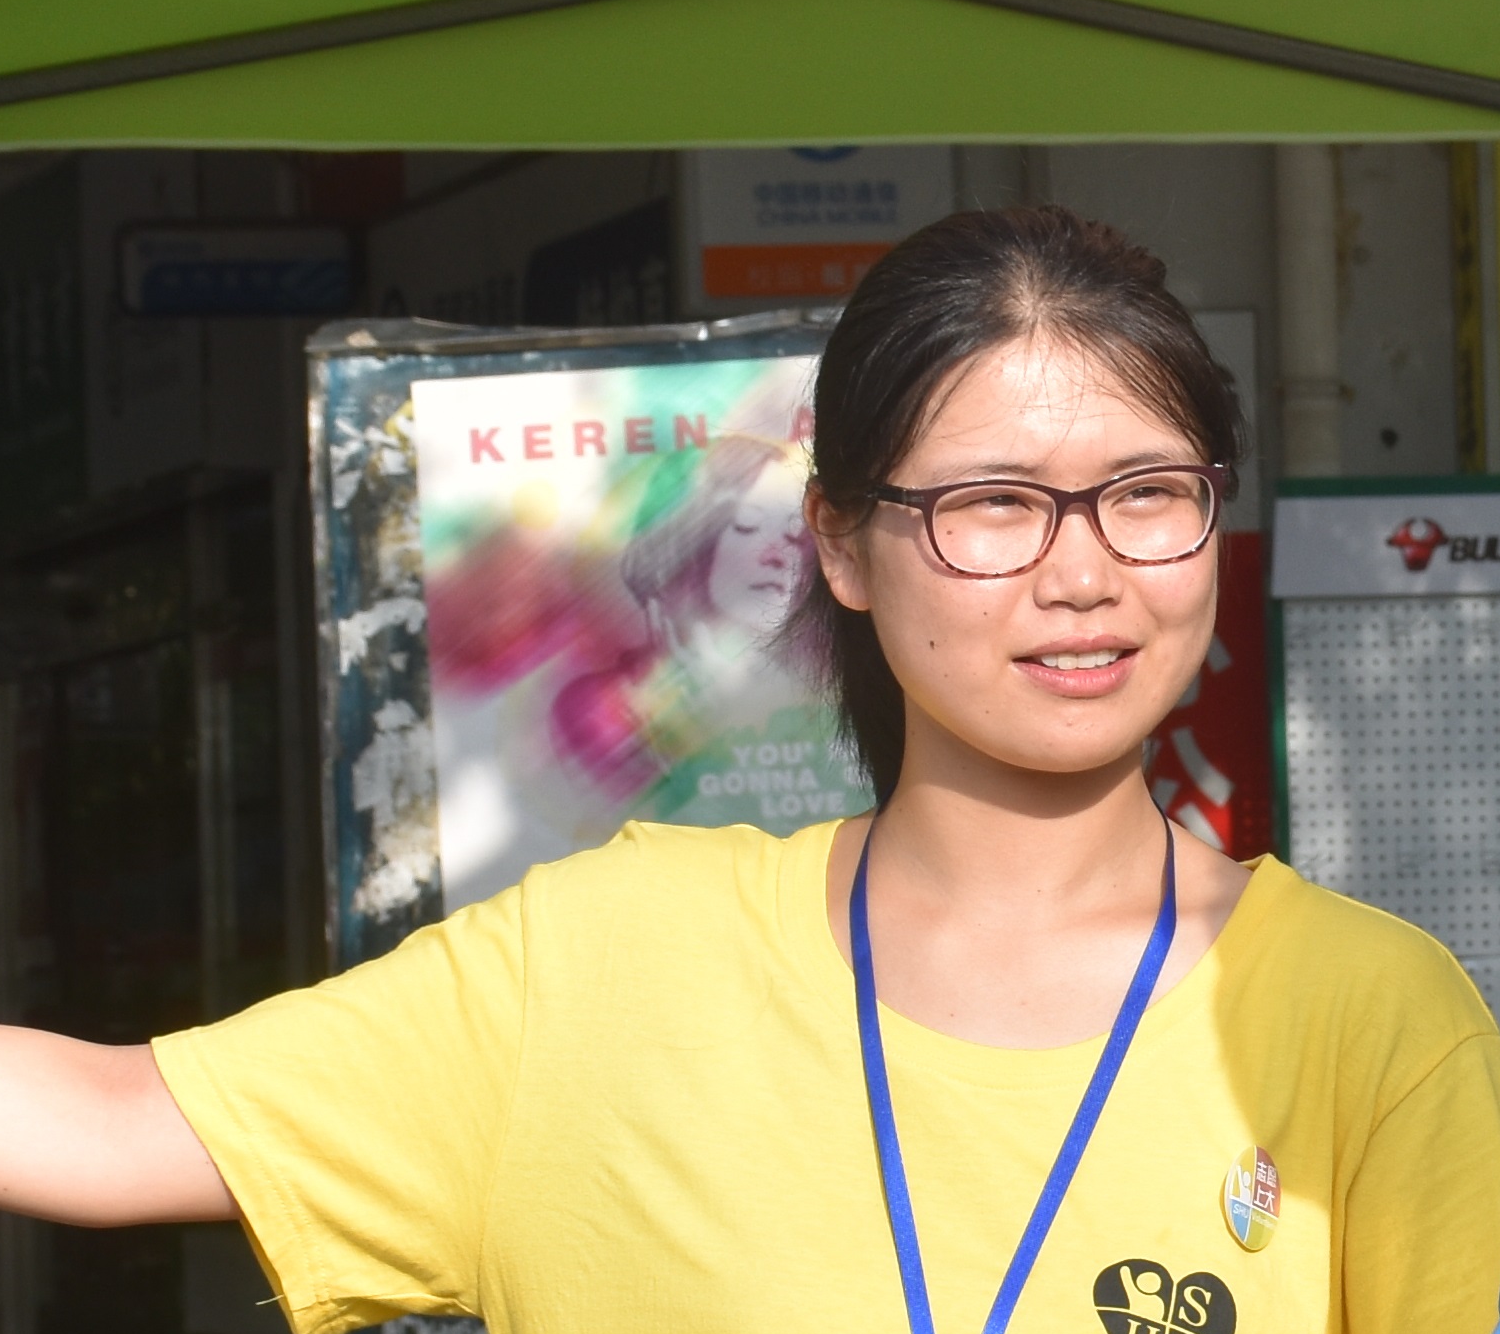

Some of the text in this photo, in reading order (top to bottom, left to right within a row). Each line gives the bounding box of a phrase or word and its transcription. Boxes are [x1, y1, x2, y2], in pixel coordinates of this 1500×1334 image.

[468, 413, 711, 466] KEREN
[697, 768, 821, 797] GONNA
[760, 790, 847, 819] LOVE
